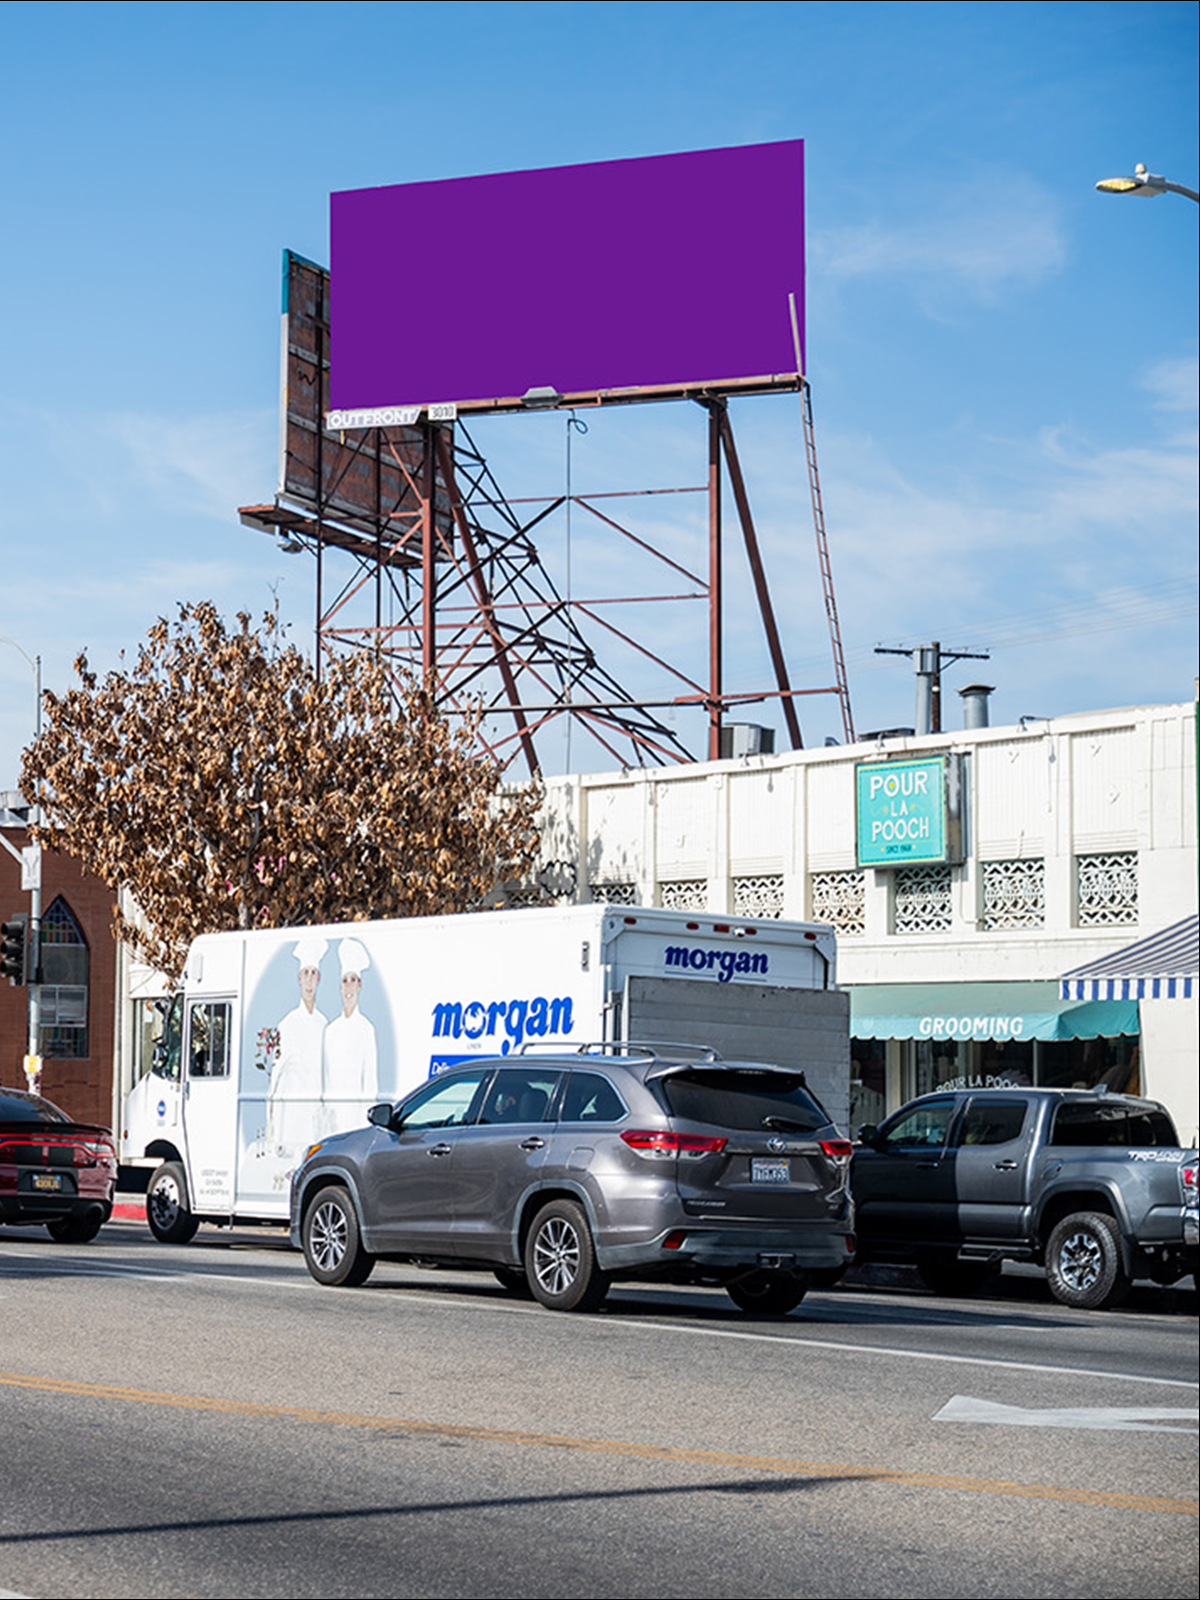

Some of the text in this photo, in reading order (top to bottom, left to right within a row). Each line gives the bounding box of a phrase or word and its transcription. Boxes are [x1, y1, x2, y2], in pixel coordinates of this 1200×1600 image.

[331, 408, 419, 427] OUTFRONT
[430, 406, 455, 419] 3010
[870, 771, 929, 800] POUR
[890, 800, 909, 817] LA
[872, 816, 930, 842] POOCH
[664, 945, 769, 984] morgan
[431, 996, 575, 1057] morgan
[919, 1016, 1024, 1036] GROOMING
[968, 1074, 983, 1088] LA
